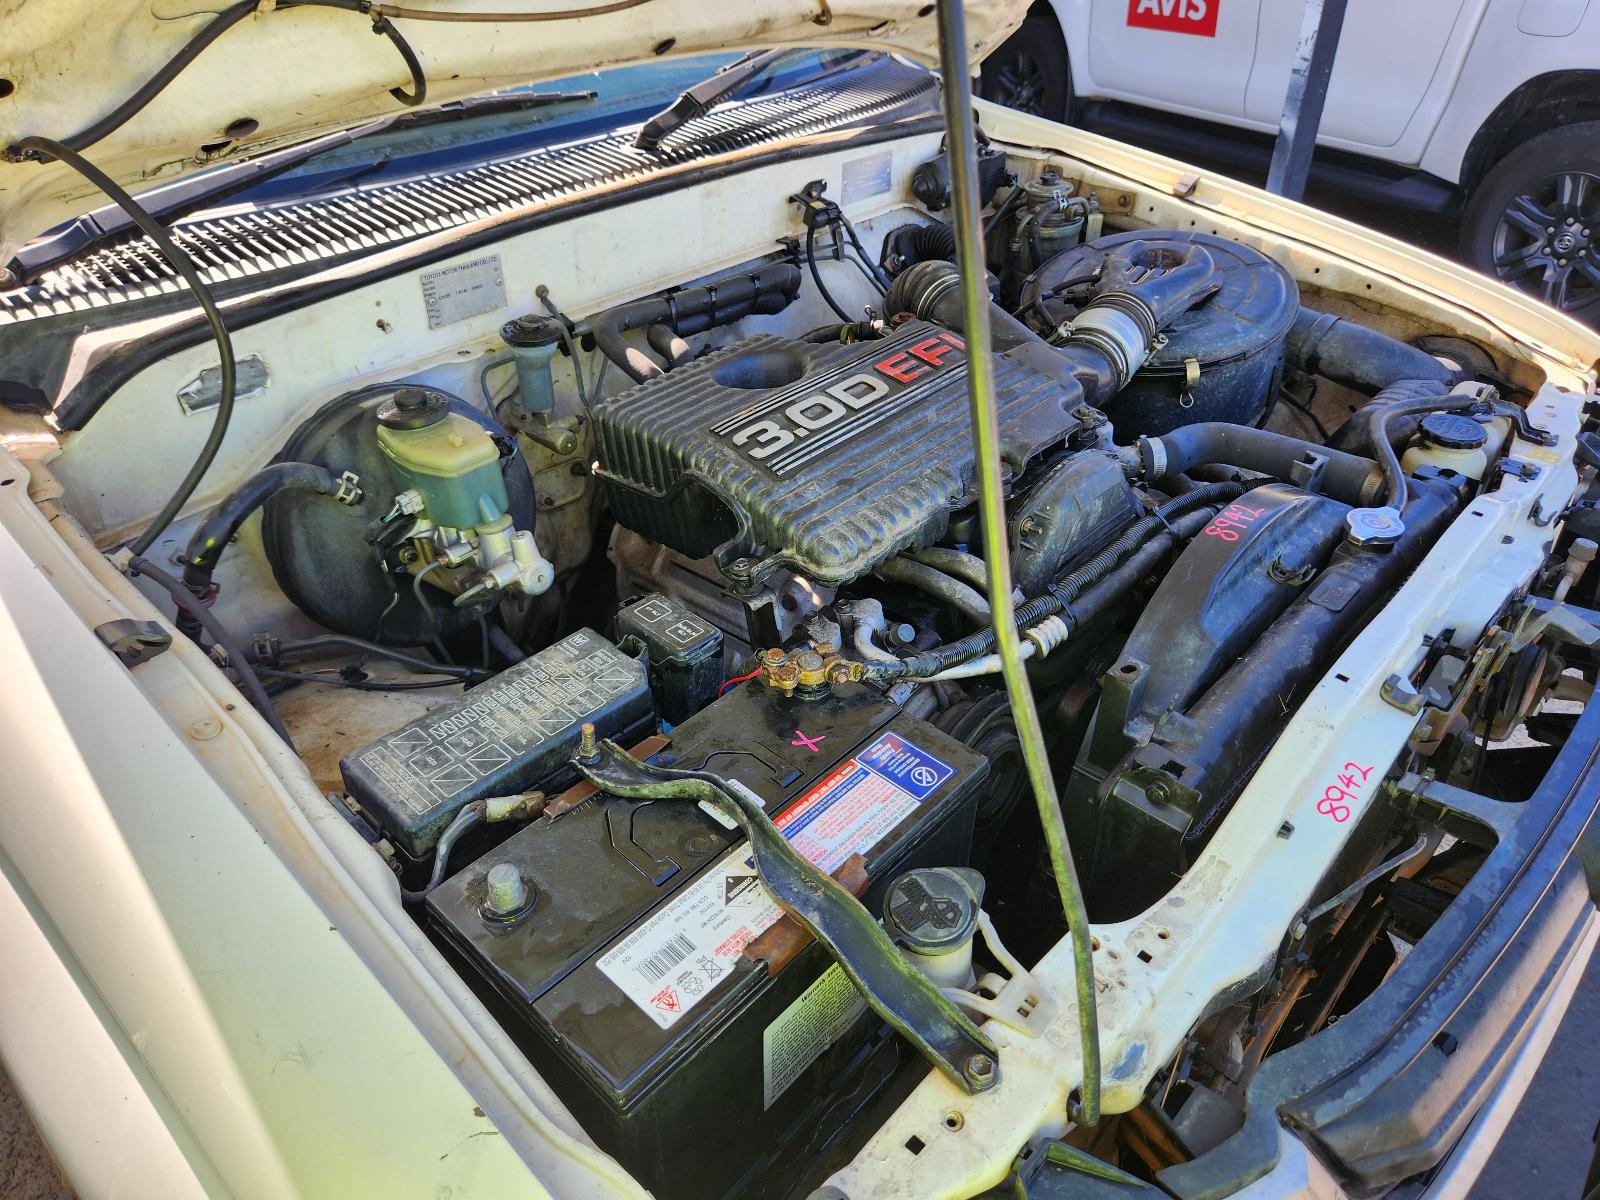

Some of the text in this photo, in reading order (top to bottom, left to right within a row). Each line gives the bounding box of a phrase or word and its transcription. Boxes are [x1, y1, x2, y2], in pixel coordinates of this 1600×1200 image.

[1137, 0, 1207, 21] AVIS
[424, 273, 441, 281] TOYOTA
[442, 268, 458, 276] MOTOR
[1204, 503, 1265, 541] 8942
[397, 768, 414, 784] NOTICE
[806, 792, 819, 802] KEEP
[1316, 762, 1376, 823] 8942
[790, 800, 809, 816] UPRIGHT
[726, 875, 753, 900] CORROSIVE
[712, 913, 731, 932] Century
[620, 954, 632, 964] 12V
[695, 954, 707, 966] Pb
